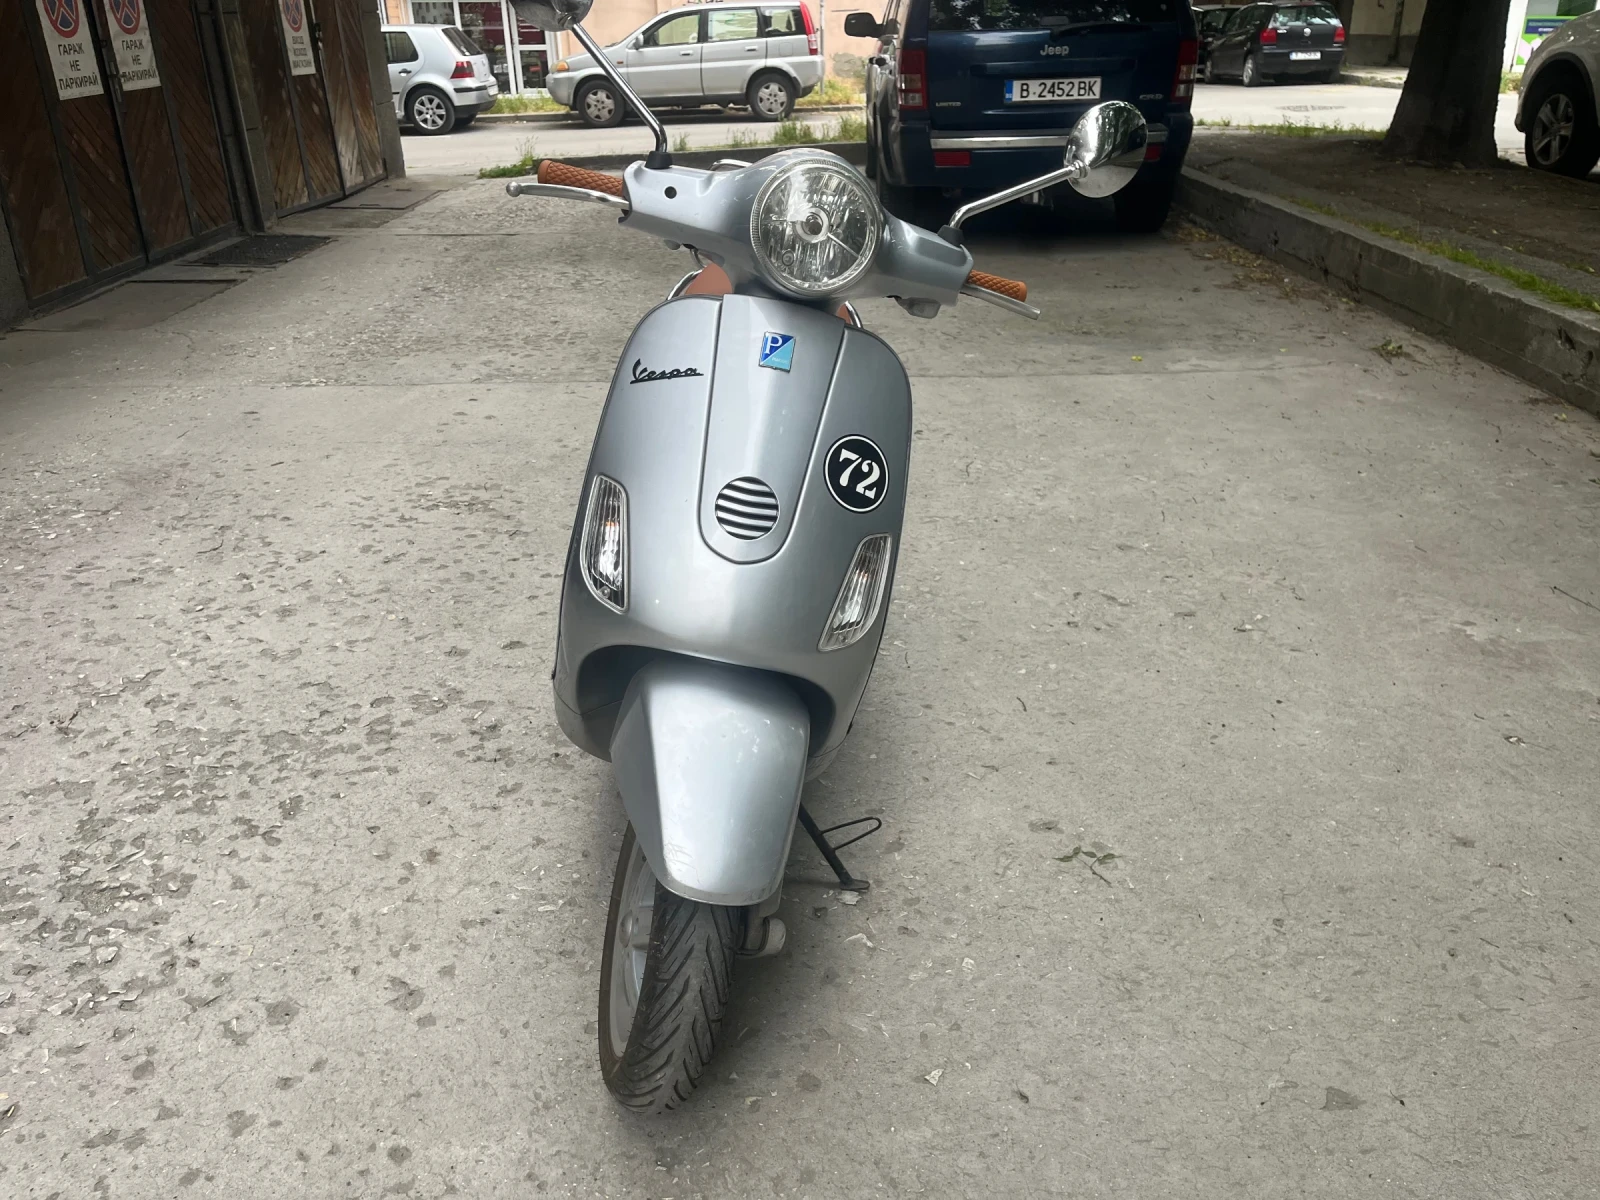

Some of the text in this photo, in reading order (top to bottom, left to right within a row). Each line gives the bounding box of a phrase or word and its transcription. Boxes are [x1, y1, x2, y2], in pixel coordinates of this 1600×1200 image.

[57, 42, 85, 56] ГАРАЖ
[121, 39, 145, 51] ГАРАЖ
[1040, 45, 1069, 56] Jeep
[69, 59, 81, 72] НЕ
[131, 54, 142, 66] НЕ
[58, 72, 99, 91] ПАРКИРАЙ
[629, 358, 705, 385] Vespa
[839, 448, 881, 500] 72
